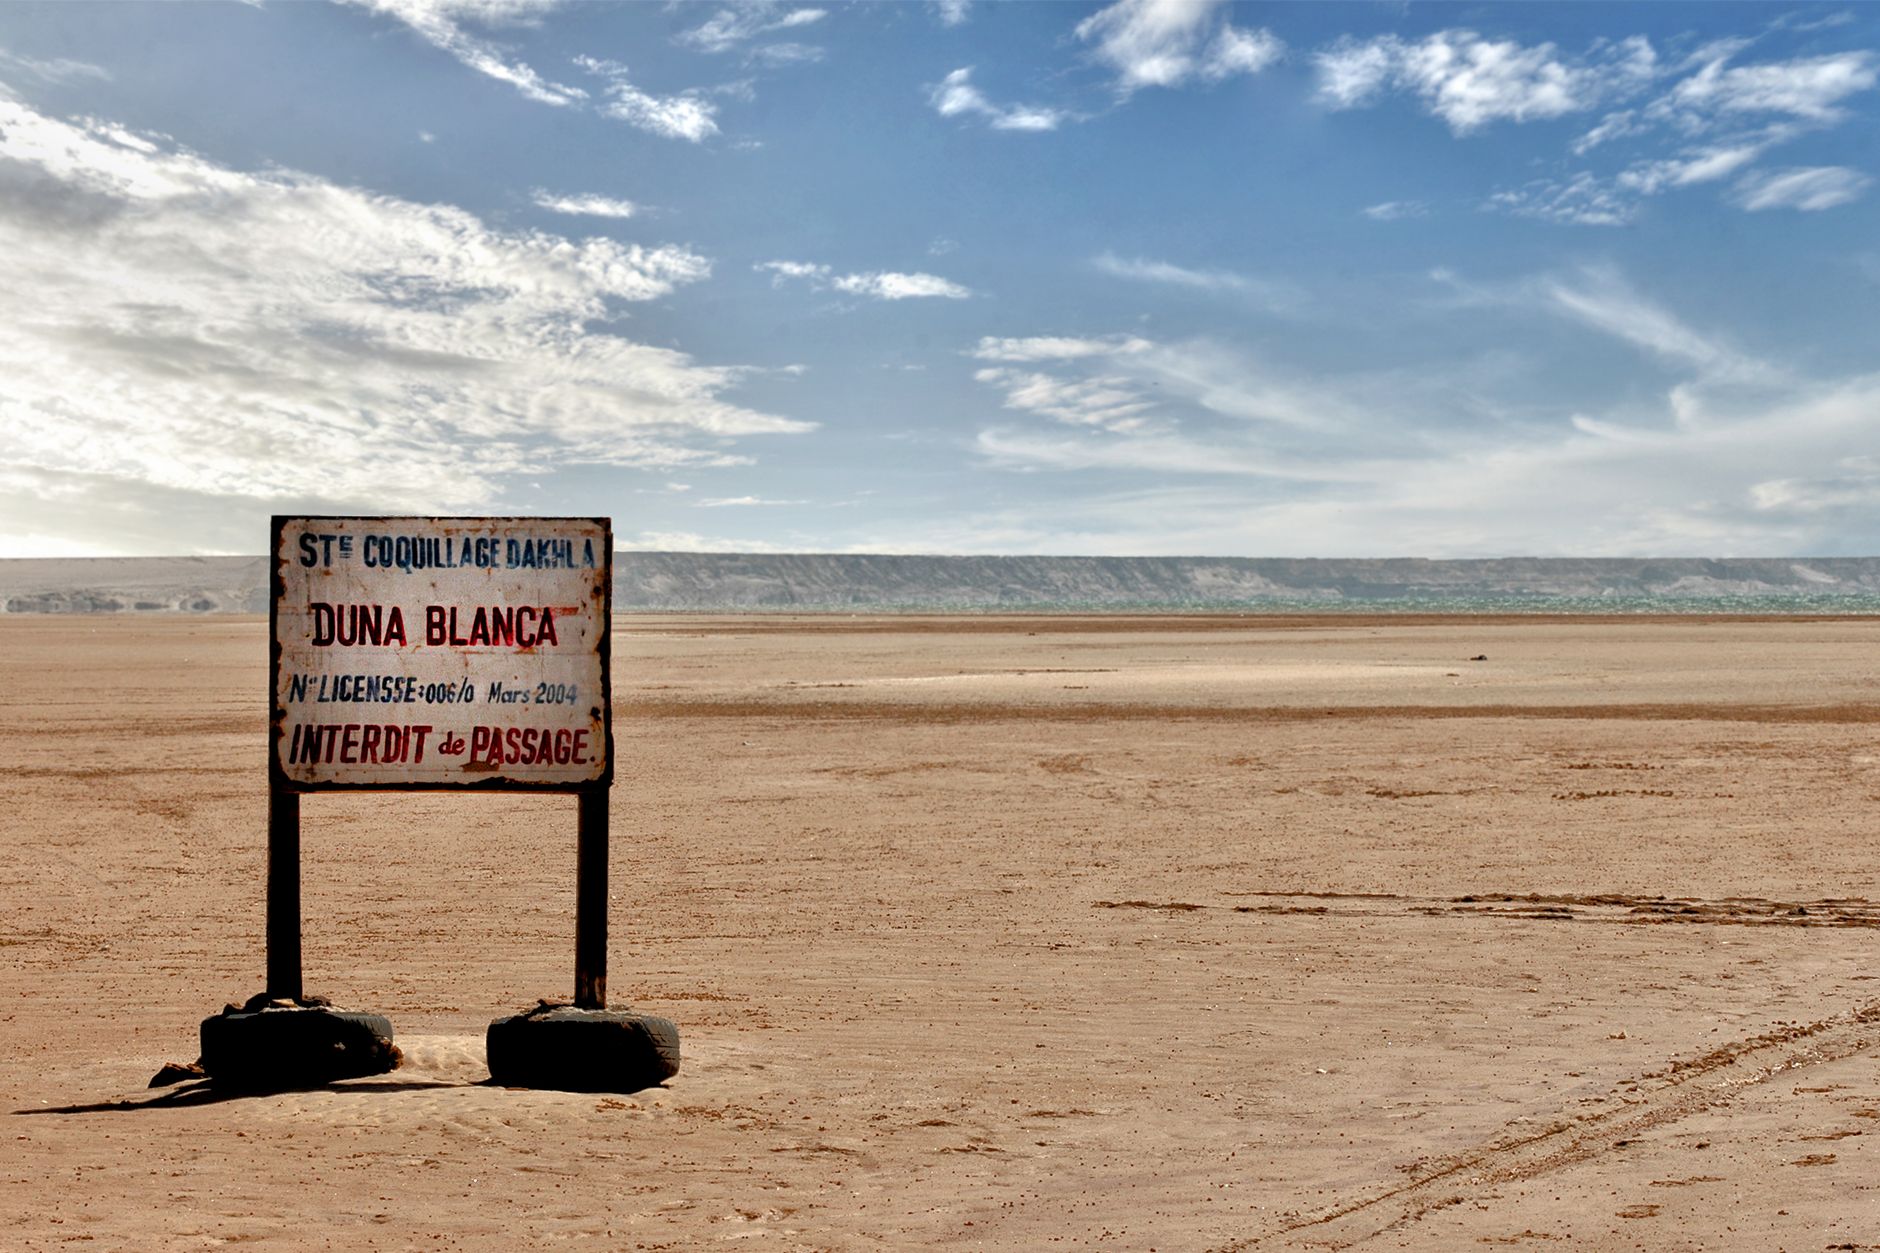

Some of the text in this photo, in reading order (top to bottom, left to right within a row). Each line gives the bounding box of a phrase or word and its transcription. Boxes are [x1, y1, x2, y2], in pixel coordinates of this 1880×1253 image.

[363, 534, 501, 574] COQUILLAGE
[506, 538, 596, 569] DAKHLA
[310, 603, 558, 647] DUNA BLANCA
[488, 681, 530, 704] Mars
[535, 682, 578, 705] 2004
[288, 724, 432, 764] INTERDIT
[438, 731, 465, 756] de
